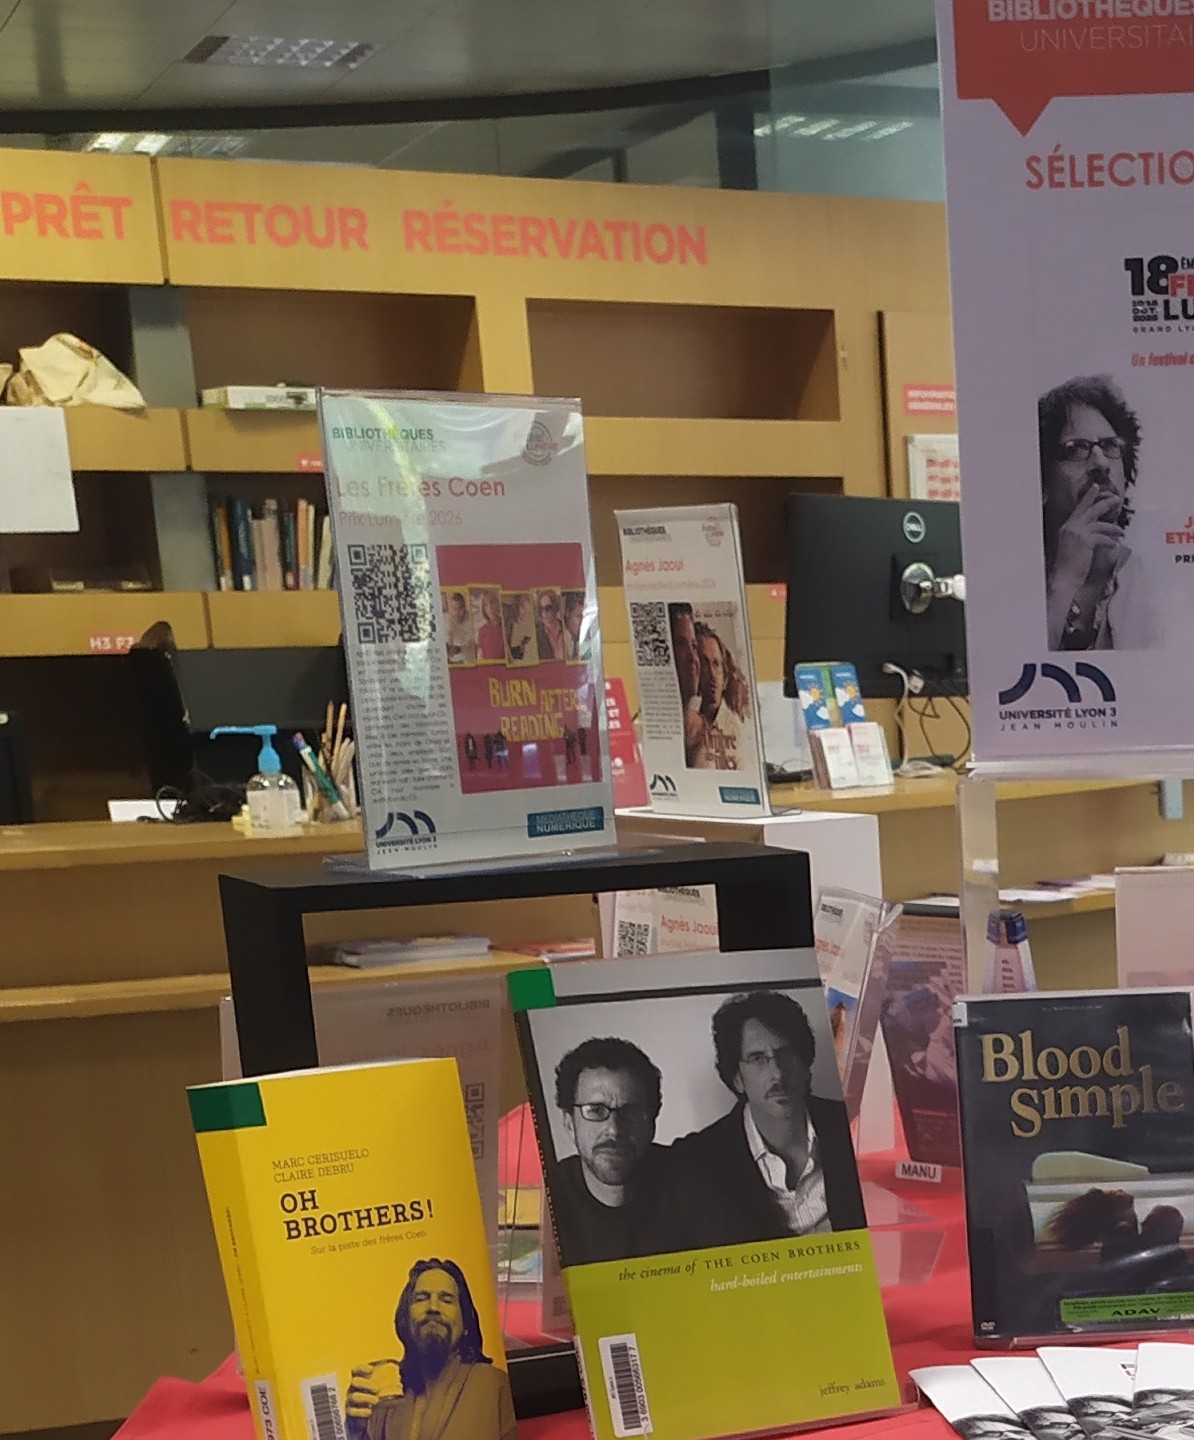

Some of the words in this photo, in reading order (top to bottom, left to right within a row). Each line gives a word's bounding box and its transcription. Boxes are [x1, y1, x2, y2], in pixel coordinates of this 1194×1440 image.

[3, 182, 132, 241] PRÊT
[171, 201, 369, 251] RETOUR
[403, 200, 710, 266] RÉSERVATION
[1132, 325, 1172, 334] GRAND
[449, 477, 505, 497] Coen
[625, 559, 657, 575] Agnès
[658, 559, 685, 572] Jaoui
[489, 677, 538, 708] BURN
[999, 706, 1072, 720] UNIVERSITÉ
[1074, 707, 1106, 719] LYON
[500, 713, 564, 742] READING
[980, 1025, 1135, 1083] Blood
[1010, 1065, 1186, 1139] Simple
[272, 1157, 304, 1170] MARC
[307, 1148, 370, 1166] CERISUELO
[274, 1168, 315, 1183] CLAIRE
[318, 1163, 355, 1176] DEBRU
[900, 1163, 938, 1179] MANU
[280, 1189, 320, 1214] OH
[283, 1199, 434, 1240] BROTHERS!
[338, 1241, 360, 1251] piste
[362, 1237, 377, 1247] des
[405, 1230, 427, 1240] Coen
[618, 1267, 637, 1282] the
[640, 1264, 681, 1280] cinema
[682, 1258, 698, 1276] of
[704, 1258, 733, 1270] THE
[740, 1251, 780, 1265] COEN
[788, 1240, 861, 1259] BROTHERS
[710, 1272, 778, 1292] hard-boiled
[780, 1263, 864, 1283] entertainments
[1111, 1306, 1161, 1317] ADAV
[818, 1378, 850, 1397] jeffrey
[854, 1377, 886, 1390] adams
[258, 1387, 270, 1415] COE
